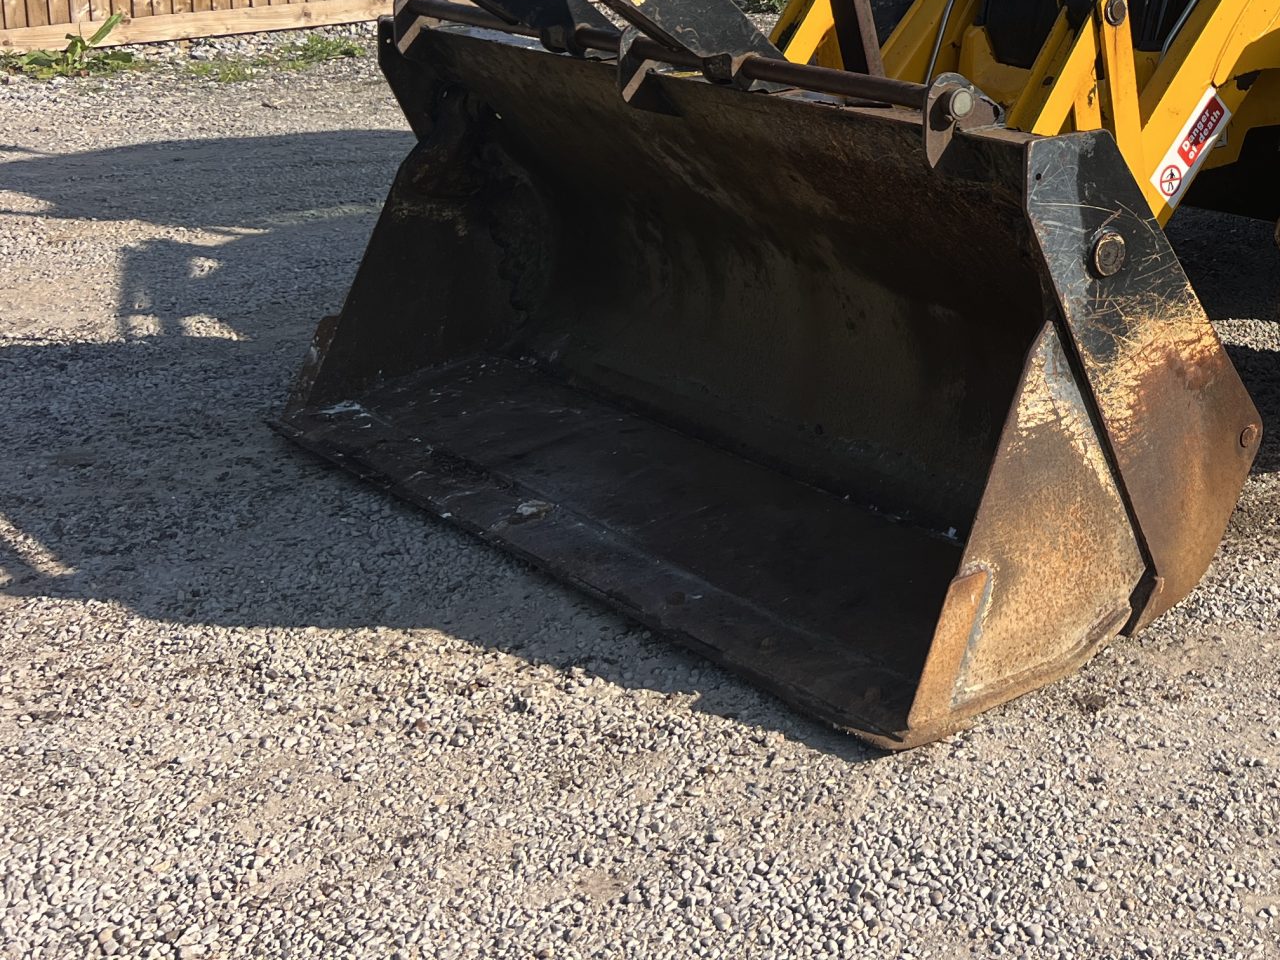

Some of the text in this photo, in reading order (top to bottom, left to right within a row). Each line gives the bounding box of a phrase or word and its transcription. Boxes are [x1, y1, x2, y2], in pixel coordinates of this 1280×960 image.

[1181, 109, 1210, 152] Danger
[1188, 109, 1221, 160] of death
